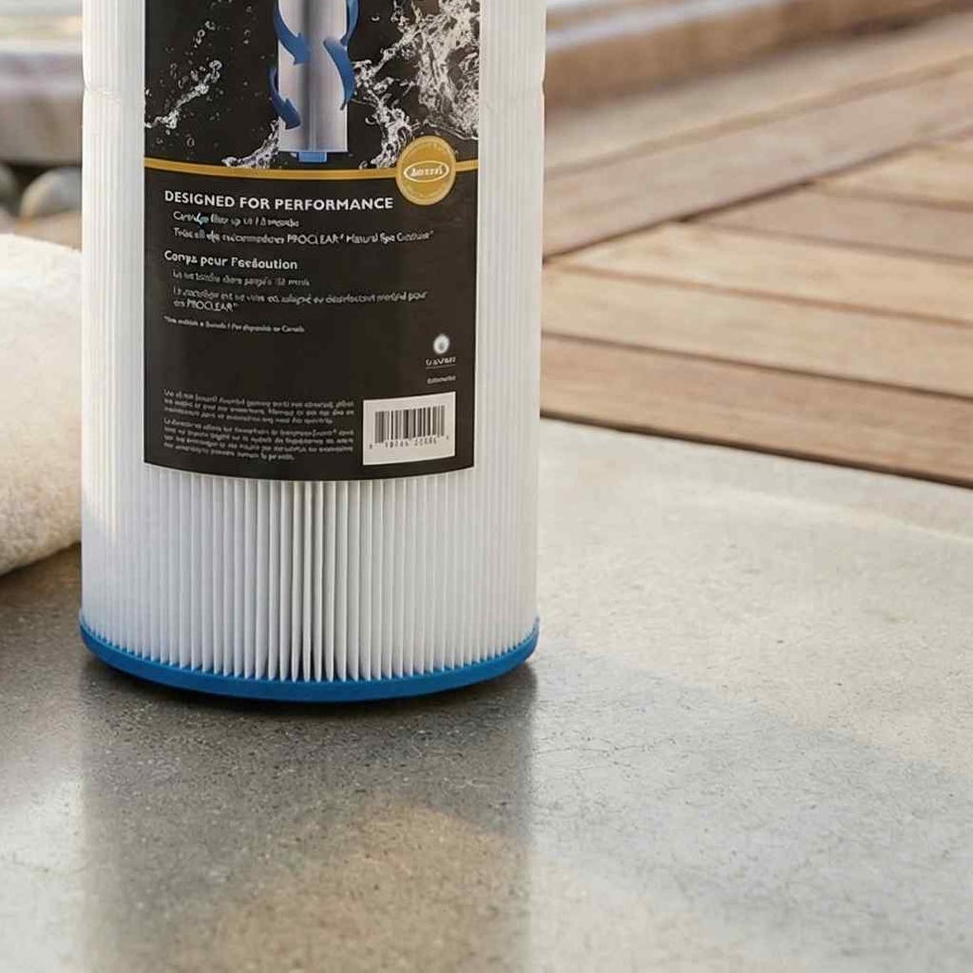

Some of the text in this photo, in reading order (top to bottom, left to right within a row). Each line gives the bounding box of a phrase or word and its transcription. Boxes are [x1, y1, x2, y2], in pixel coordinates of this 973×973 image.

[164, 190, 394, 211] DESIGNED FOR PERFORMANCE
